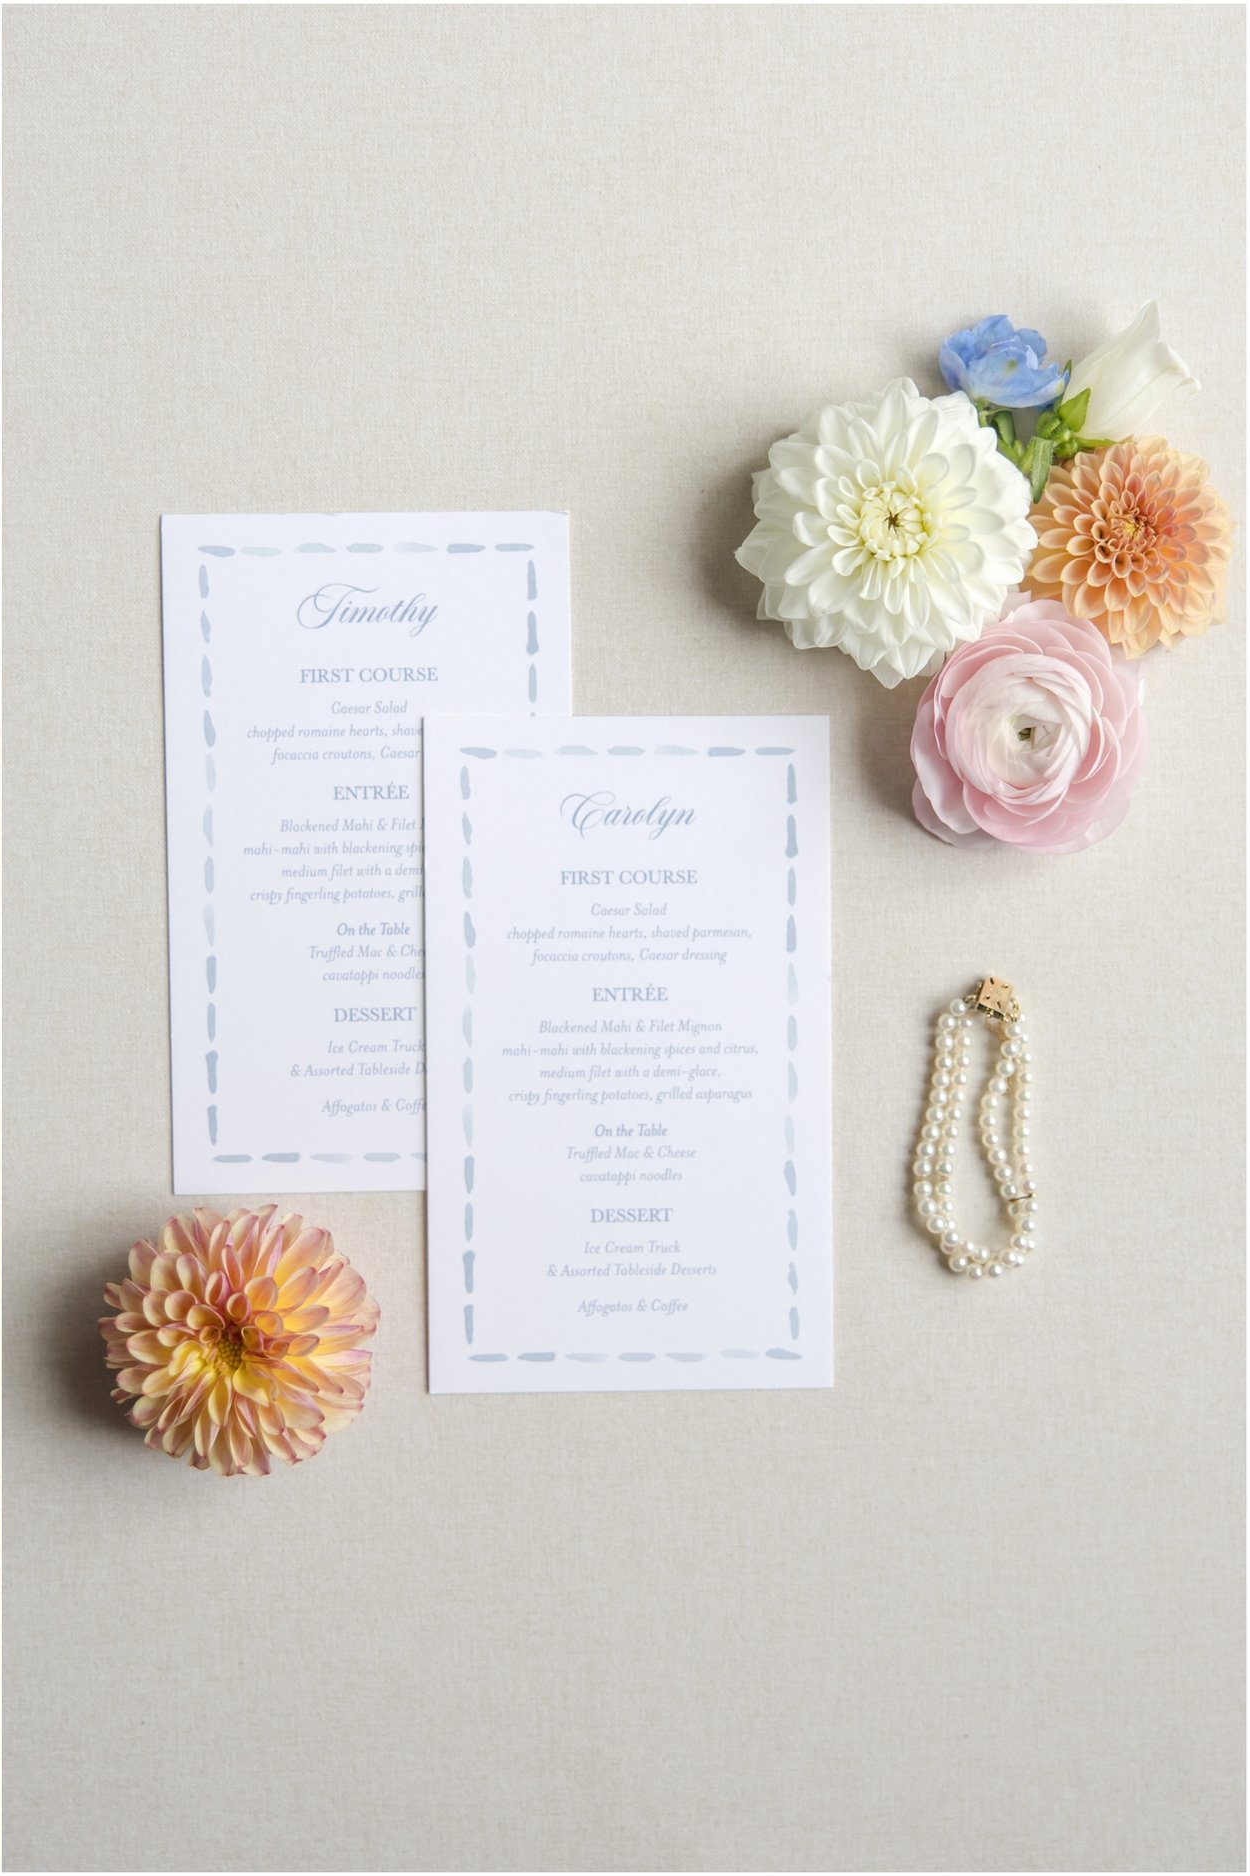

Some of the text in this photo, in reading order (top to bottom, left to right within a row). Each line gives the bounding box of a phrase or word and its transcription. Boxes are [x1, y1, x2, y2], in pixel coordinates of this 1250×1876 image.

[297, 583, 438, 637] Timothy
[300, 667, 438, 683] FIRST COURSE
[331, 700, 408, 714] Caesar Salad
[247, 725, 295, 743] chopped
[298, 727, 346, 738] romaine
[271, 747, 319, 766] focaccia
[380, 747, 420, 760] Caesar
[334, 782, 409, 801] ENTRÉE
[559, 791, 696, 840] Carolyn
[280, 819, 339, 833] Blackened
[342, 818, 373, 832] Mahi
[377, 818, 388, 831] &
[391, 818, 416, 831] Filet
[313, 841, 339, 855] with
[342, 841, 403, 858] blackening
[282, 864, 327, 878] medium
[329, 864, 353, 881] filet
[356, 863, 382, 877] with
[384, 868, 392, 877] a
[560, 869, 698, 885] FIRST COURSE
[250, 888, 283, 905] crispy
[285, 887, 340, 905] fingerling
[591, 902, 667, 917] Caesar Salad
[337, 922, 410, 936] On the Table
[507, 926, 555, 944] chopped
[557, 928, 606, 939] romaine
[650, 925, 690, 939] shaved
[309, 945, 354, 963] Truffled
[357, 945, 382, 958] Mac
[386, 944, 397, 958] &
[530, 949, 579, 966] focaccia
[639, 948, 679, 961] Caesar
[682, 947, 728, 964] dressing
[323, 969, 379, 985] cavatappi
[592, 984, 668, 1002] ENTRÉE
[334, 1007, 417, 1022] DESSERT
[539, 1019, 722, 1036] Blackened Mahi & Filet Mignon
[328, 1038, 425, 1053] Ice Cream Truck
[572, 1043, 598, 1056] with
[600, 1042, 662, 1059] blackening
[663, 1043, 696, 1059] spices
[698, 1041, 721, 1055] and
[291, 1064, 301, 1077] &
[304, 1063, 355, 1076] Assorted
[358, 1062, 411, 1076] Tableside
[540, 1066, 586, 1079] medium
[588, 1065, 612, 1082] filet
[615, 1064, 640, 1078] with
[642, 1068, 650, 1078] a
[509, 1090, 541, 1105] crispy
[542, 1088, 599, 1105] fingerling
[655, 1086, 694, 1104] grilled
[696, 1089, 753, 1104] asparagus
[321, 1099, 377, 1117] Affogatos
[381, 1098, 392, 1111] &
[594, 1123, 668, 1137] On the Table
[566, 1145, 696, 1164] Truffled Mac & Cheese
[579, 1168, 682, 1186] cavatappi noodles
[591, 1207, 673, 1223] DESSERT
[584, 1240, 680, 1254] Ice Cream Truck
[547, 1262, 717, 1277] & Assorted Tableside Desserts
[577, 1298, 689, 1317] Affogatos & Coffee
